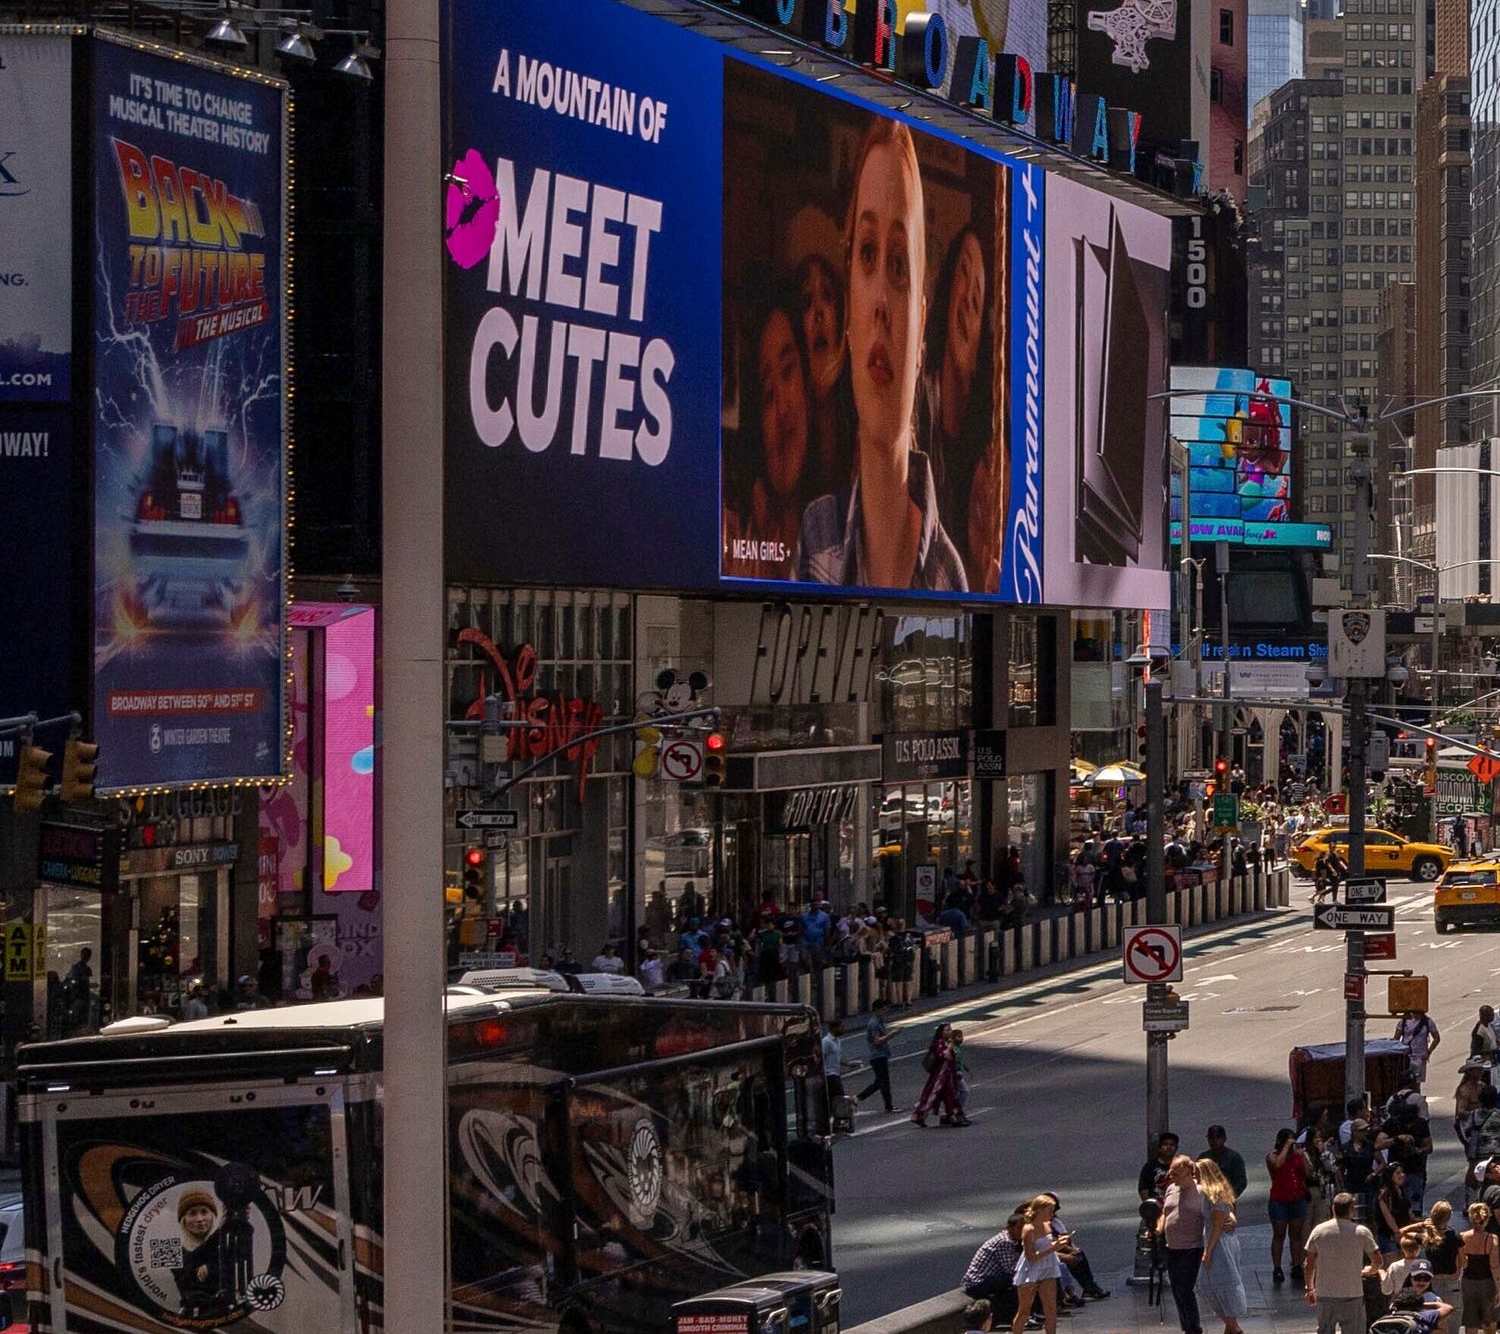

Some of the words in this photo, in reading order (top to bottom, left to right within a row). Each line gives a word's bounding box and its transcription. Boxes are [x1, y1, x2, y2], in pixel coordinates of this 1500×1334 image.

[130, 73, 153, 98] IT'S
[154, 80, 183, 106] TIME
[185, 88, 202, 112] TO
[204, 92, 252, 125] CHANGE
[492, 48, 511, 96] A
[516, 56, 635, 136] MOUNTAIN
[637, 96, 668, 144] OF
[109, 95, 164, 130] MUSICAL
[166, 111, 220, 142] THEATER
[221, 127, 270, 155] HISTORY
[112, 136, 242, 249] BACK
[486, 156, 663, 321] MEET
[129, 244, 160, 288] TO
[160, 250, 266, 316] FUTURE
[195, 317, 219, 340] THE
[220, 306, 264, 333] MUSICAL
[469, 306, 675, 466] CUTES
[732, 540, 758, 560] MEAN
[760, 541, 785, 563] GIRLS
[752, 602, 884, 704] FOREVER
[913, 739, 935, 762] POLO
[465, 815, 481, 824] ONE
[492, 815, 509, 824] WAY
[175, 849, 209, 864] SONY
[1327, 913, 1348, 922] ONE
[1360, 913, 1383, 922] WAY
